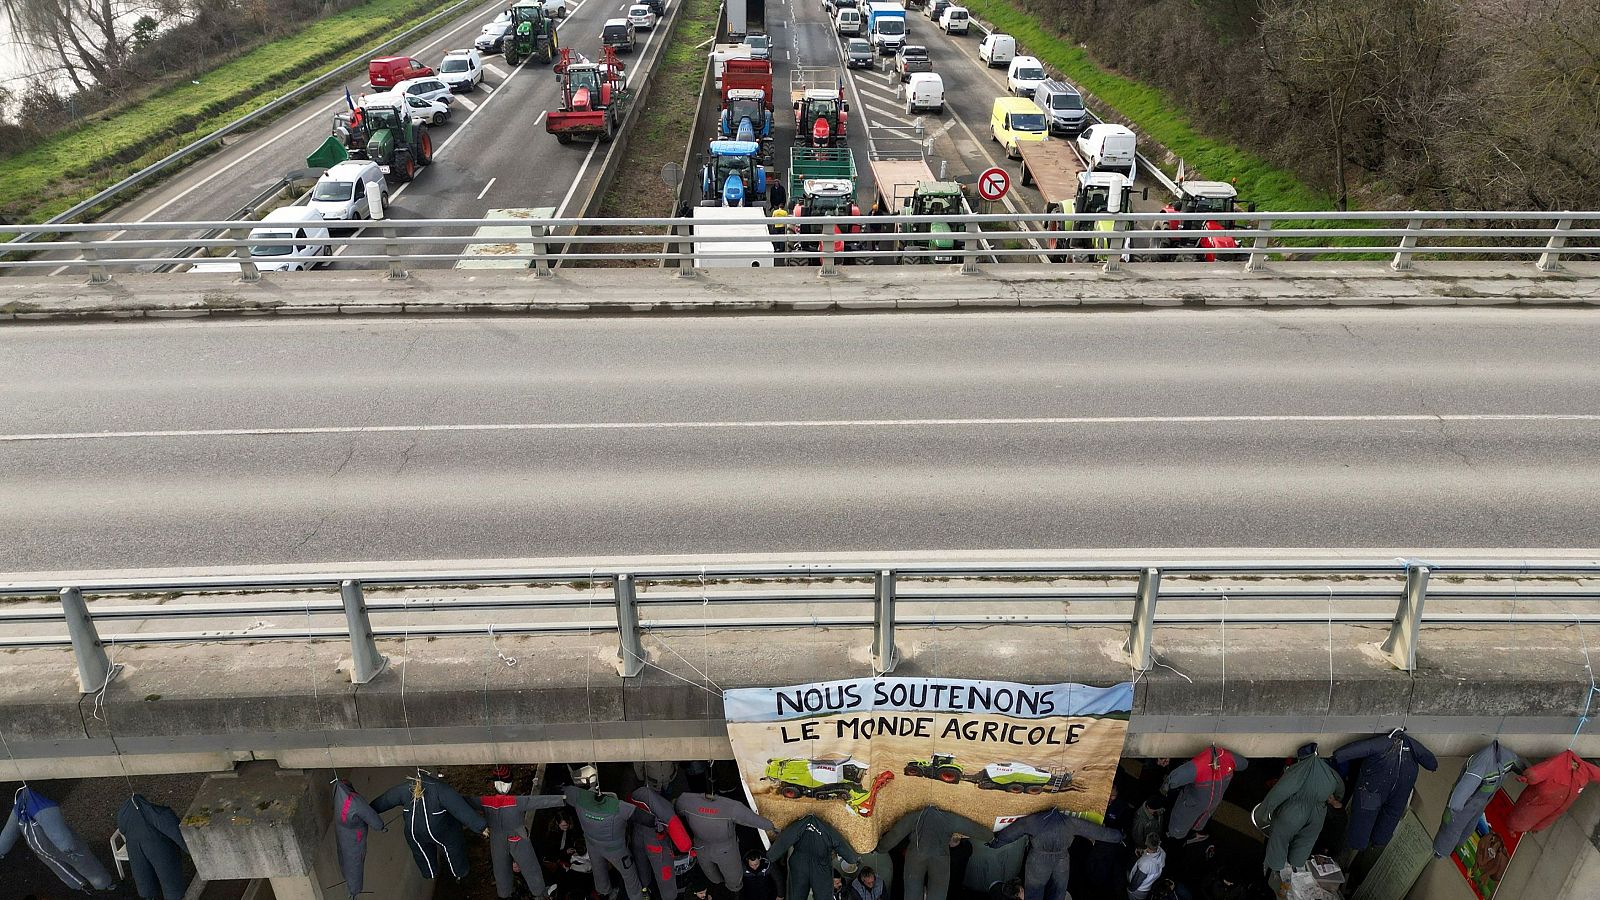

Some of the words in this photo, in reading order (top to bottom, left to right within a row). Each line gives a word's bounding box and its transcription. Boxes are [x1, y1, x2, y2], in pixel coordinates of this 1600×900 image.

[776, 683, 862, 716] NOUS
[873, 681, 1055, 715] SOUTENONS
[780, 721, 820, 744] LE
[836, 716, 934, 740] MONDE
[940, 718, 1085, 746] AGRICOLE
